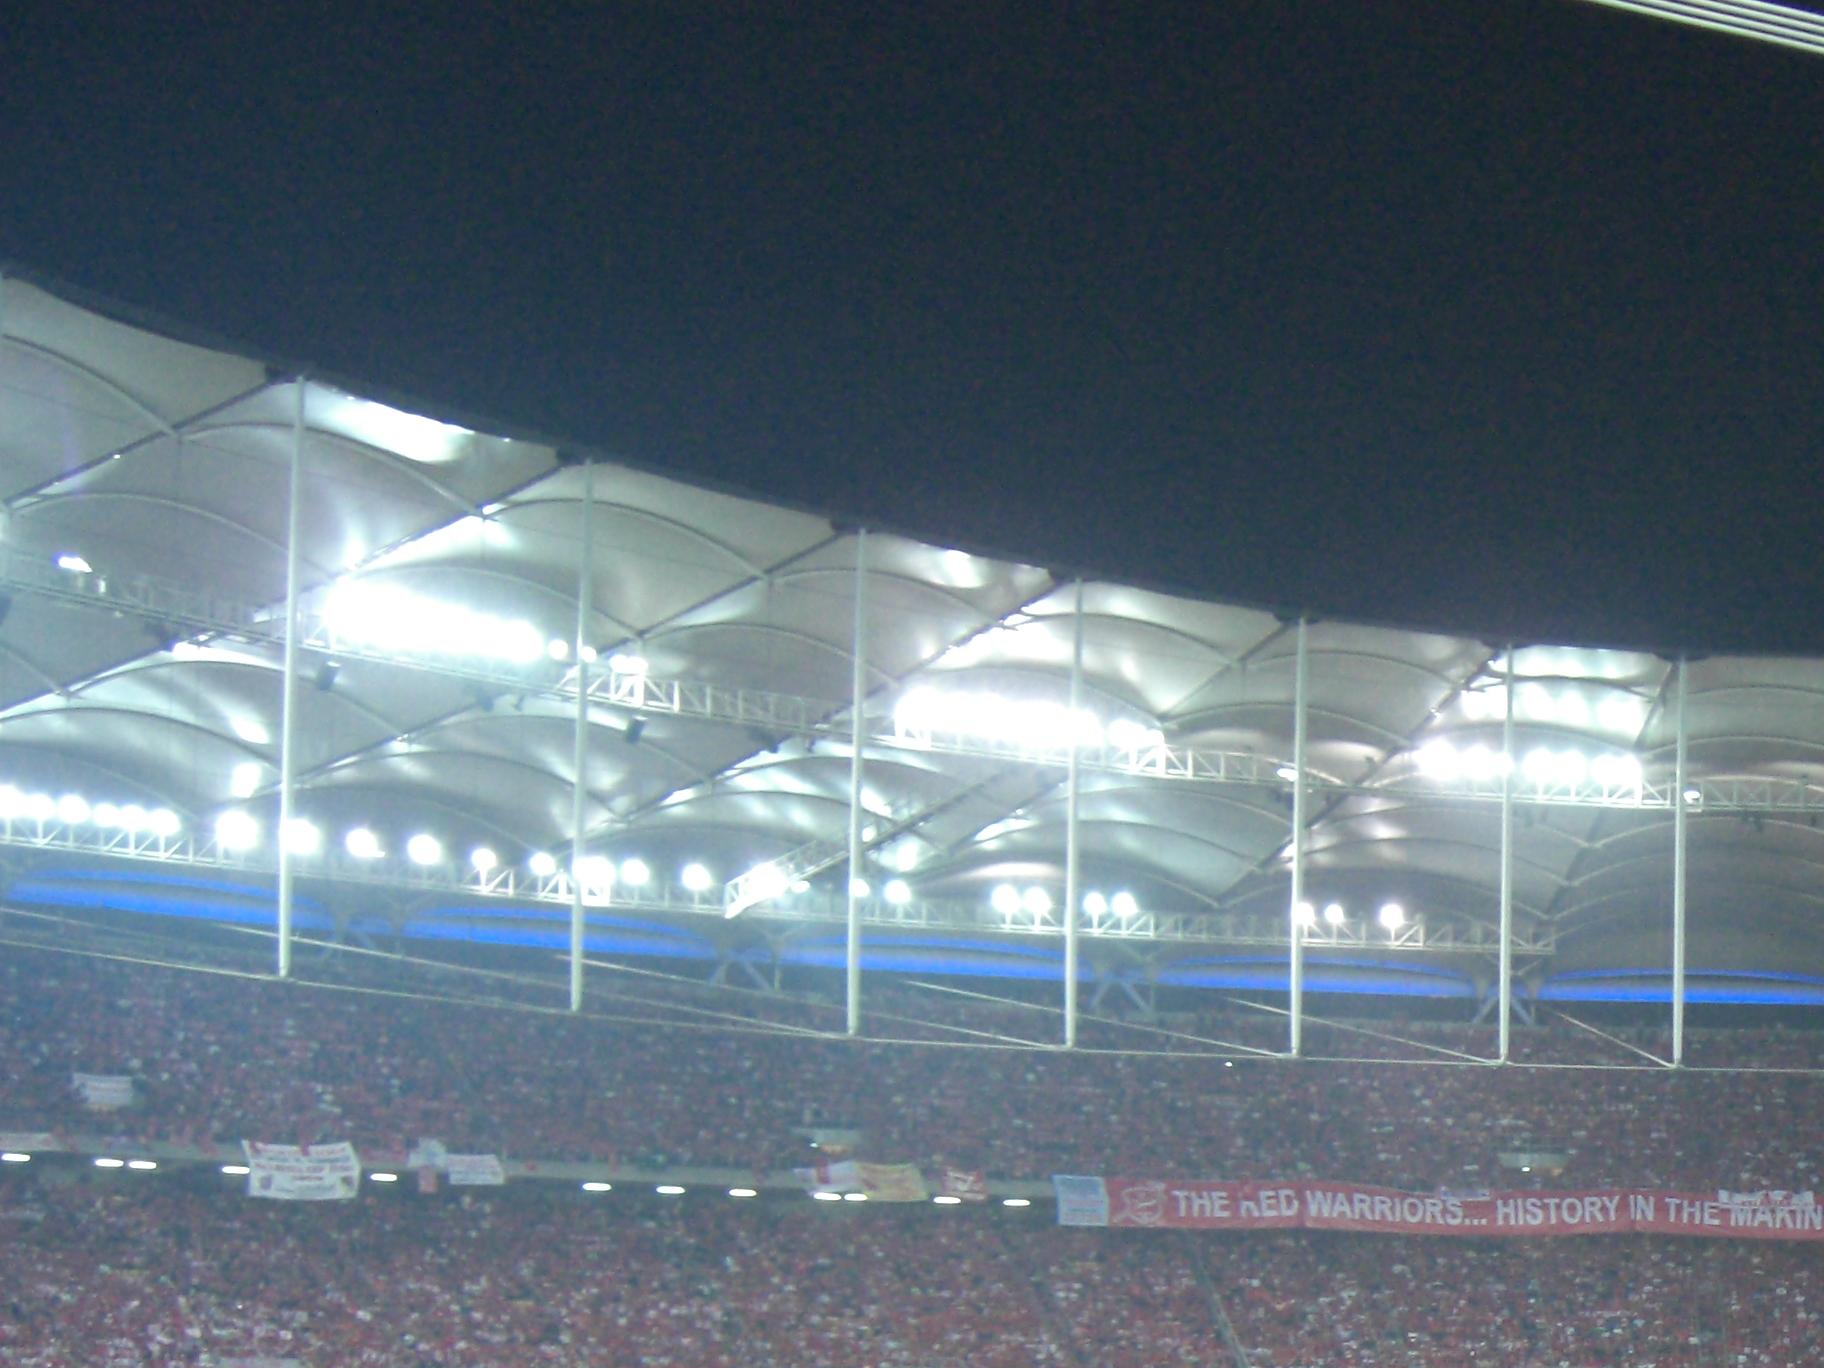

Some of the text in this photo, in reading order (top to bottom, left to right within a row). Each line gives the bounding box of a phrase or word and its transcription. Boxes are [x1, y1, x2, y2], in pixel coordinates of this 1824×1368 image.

[1171, 1189, 1231, 1218] THE
[1239, 1188, 1299, 1218] RED
[1497, 1196, 1620, 1226] HISTORY
[1630, 1194, 1656, 1220] IN
[1665, 1198, 1721, 1226] THE
